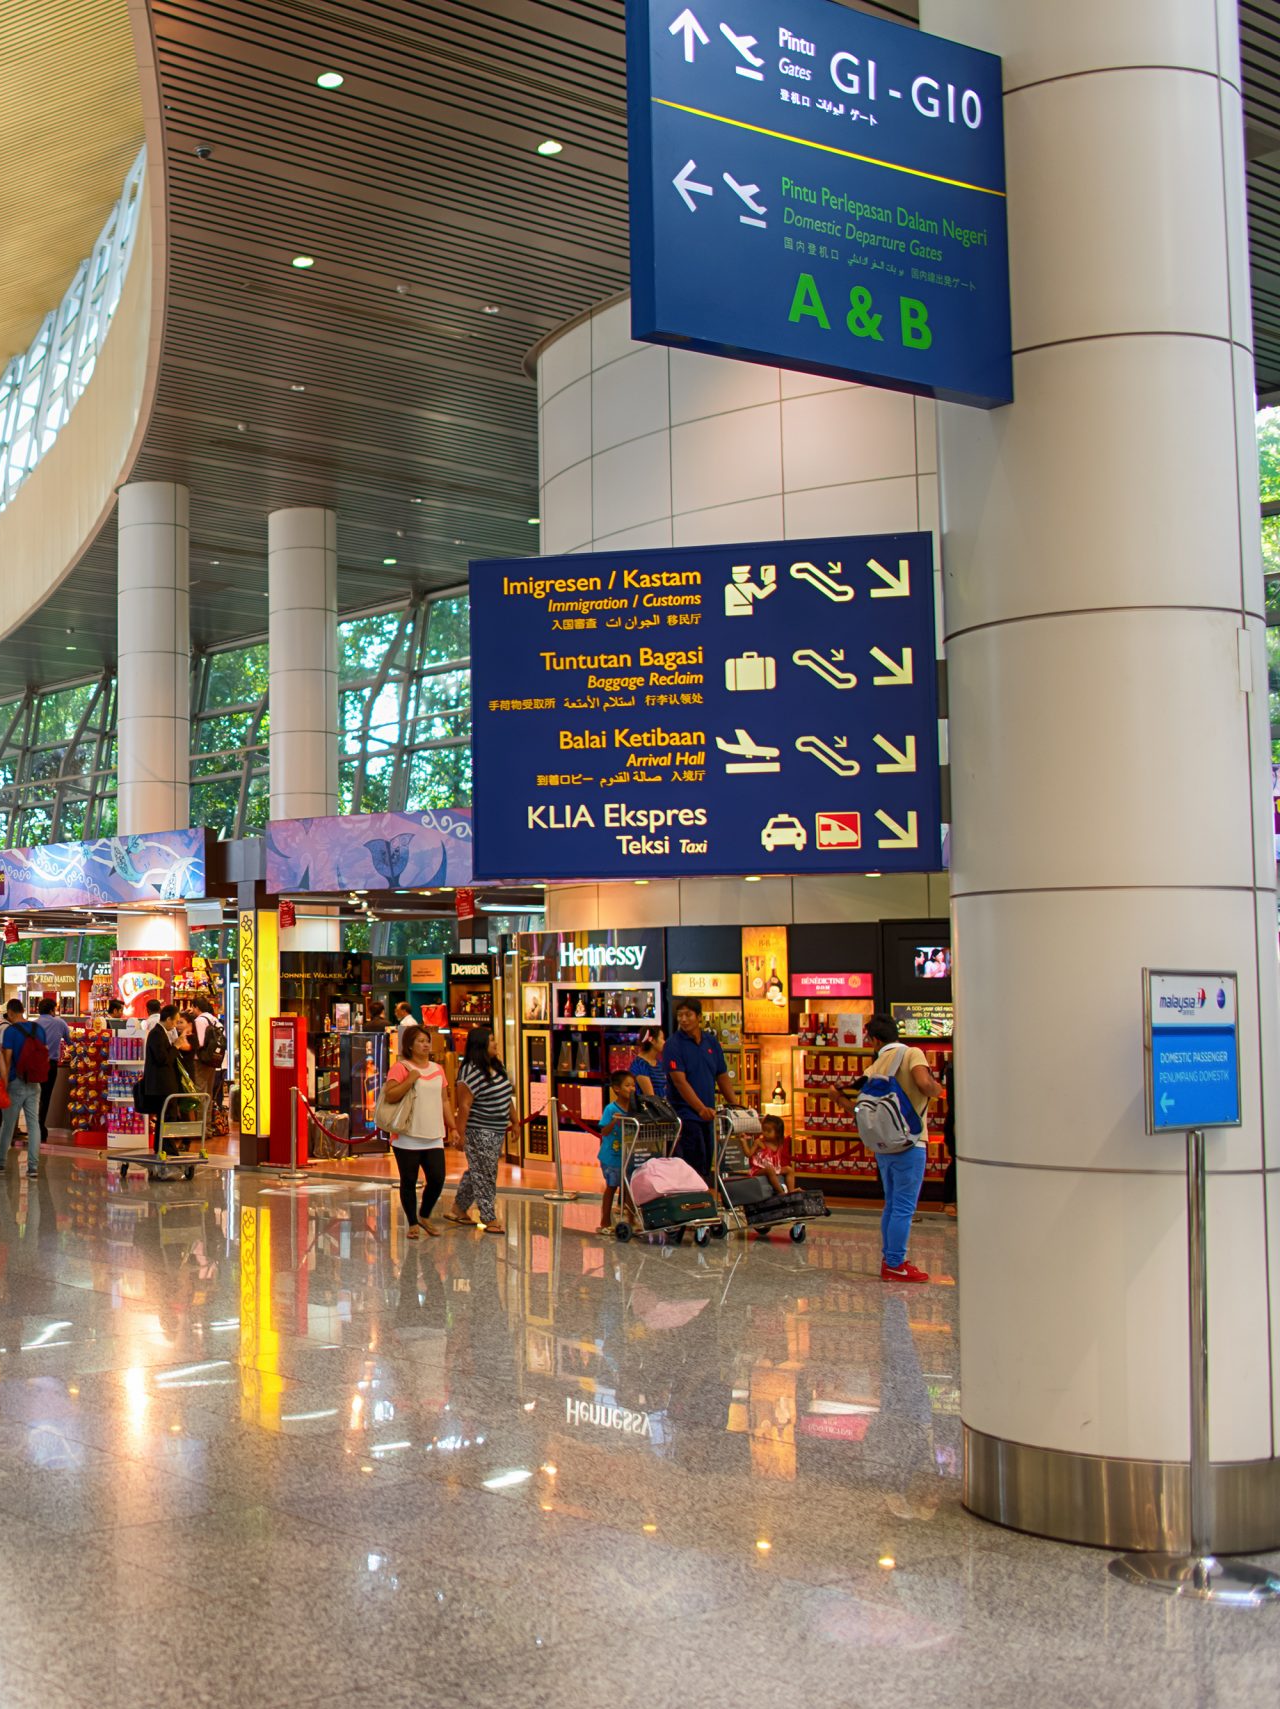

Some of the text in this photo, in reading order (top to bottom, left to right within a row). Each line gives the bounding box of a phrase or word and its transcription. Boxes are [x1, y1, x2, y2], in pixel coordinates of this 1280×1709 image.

[778, 27, 816, 57] Pintu
[778, 58, 812, 81] Gates
[850, 108, 878, 126] ゲート
[781, 176, 988, 248] Pintu Perlepasan Dalam Negeri
[783, 208, 943, 262] Domestic Departure Gates
[788, 272, 933, 350] A & B
[503, 569, 702, 599] Imigresen / Kastam
[548, 593, 702, 614] Immigration / Customs
[666, 613, 702, 626] 移民厅
[540, 646, 704, 671] Tuntutan Bagasi
[587, 672, 704, 692] Baggage Reclaim
[645, 693, 704, 706] 行李认领处
[559, 727, 706, 750] Balai Ketibaan
[626, 751, 706, 768] Arrival Hall
[527, 803, 708, 833] KLIA Ekspres
[616, 835, 708, 855] Teksi Taxi
[560, 942, 647, 970] Hennessy
[1159, 995, 1195, 1012] malaysia
[1160, 1051, 1228, 1064] DOMESTIC PASSENGER
[1160, 1071, 1198, 1084] PENUMPANG
